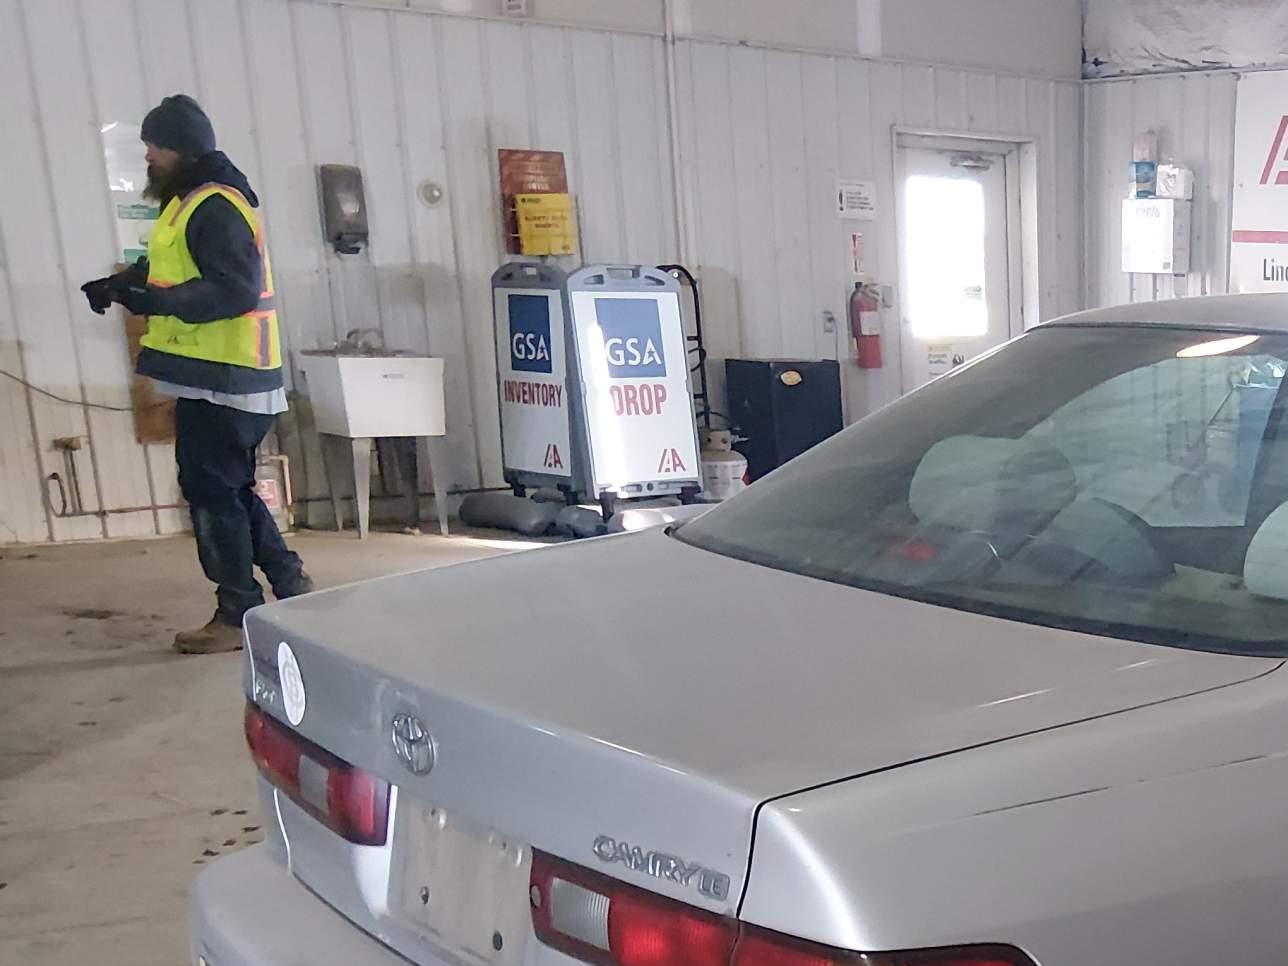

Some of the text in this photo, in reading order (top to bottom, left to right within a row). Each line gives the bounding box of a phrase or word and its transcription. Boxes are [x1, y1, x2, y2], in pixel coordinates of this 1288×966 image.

[512, 332, 550, 361] GSA
[604, 337, 662, 366] GSA
[503, 379, 562, 408] INVENTORY
[608, 383, 667, 417] DROP
[592, 834, 731, 901] CAMRY LE
